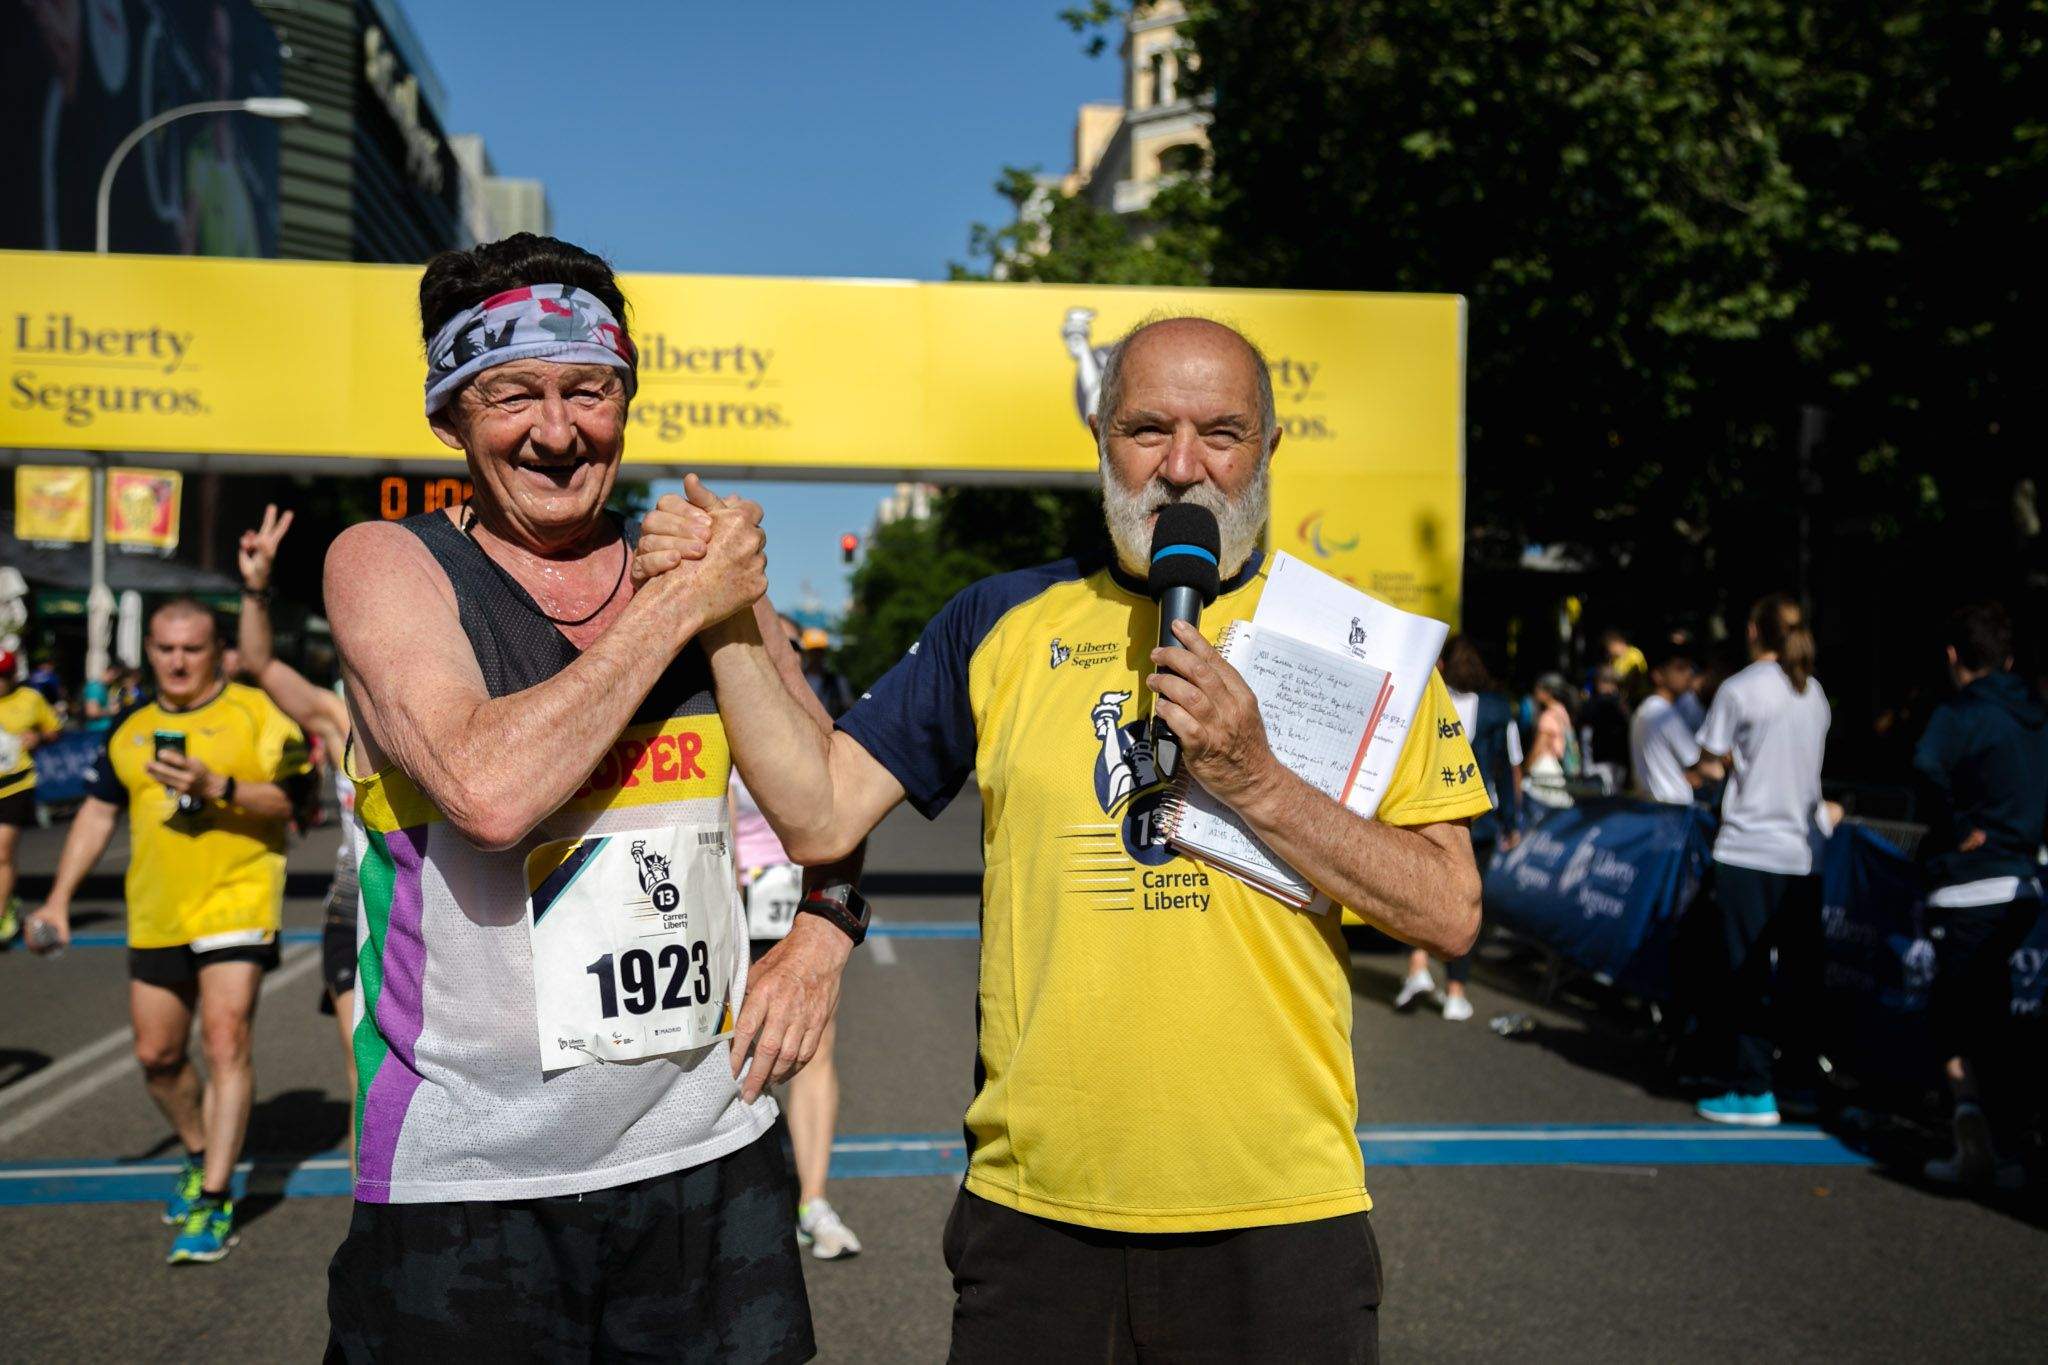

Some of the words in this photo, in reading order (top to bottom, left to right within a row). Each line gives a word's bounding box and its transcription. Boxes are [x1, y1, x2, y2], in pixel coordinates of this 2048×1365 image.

[14, 313, 194, 374] Liberty
[640, 332, 775, 390] iberty
[10, 371, 211, 427] Seguros.
[628, 399, 793, 442] eguros.
[1076, 642, 1120, 653] Liberty
[576, 732, 706, 799] OPER
[1142, 870, 1210, 889] Carrera
[657, 888, 675, 906] 13
[1144, 891, 1211, 912] Liberty
[662, 913, 688, 922] Carrera
[663, 920, 689, 930] Liberty
[586, 940, 711, 1019] 1923
